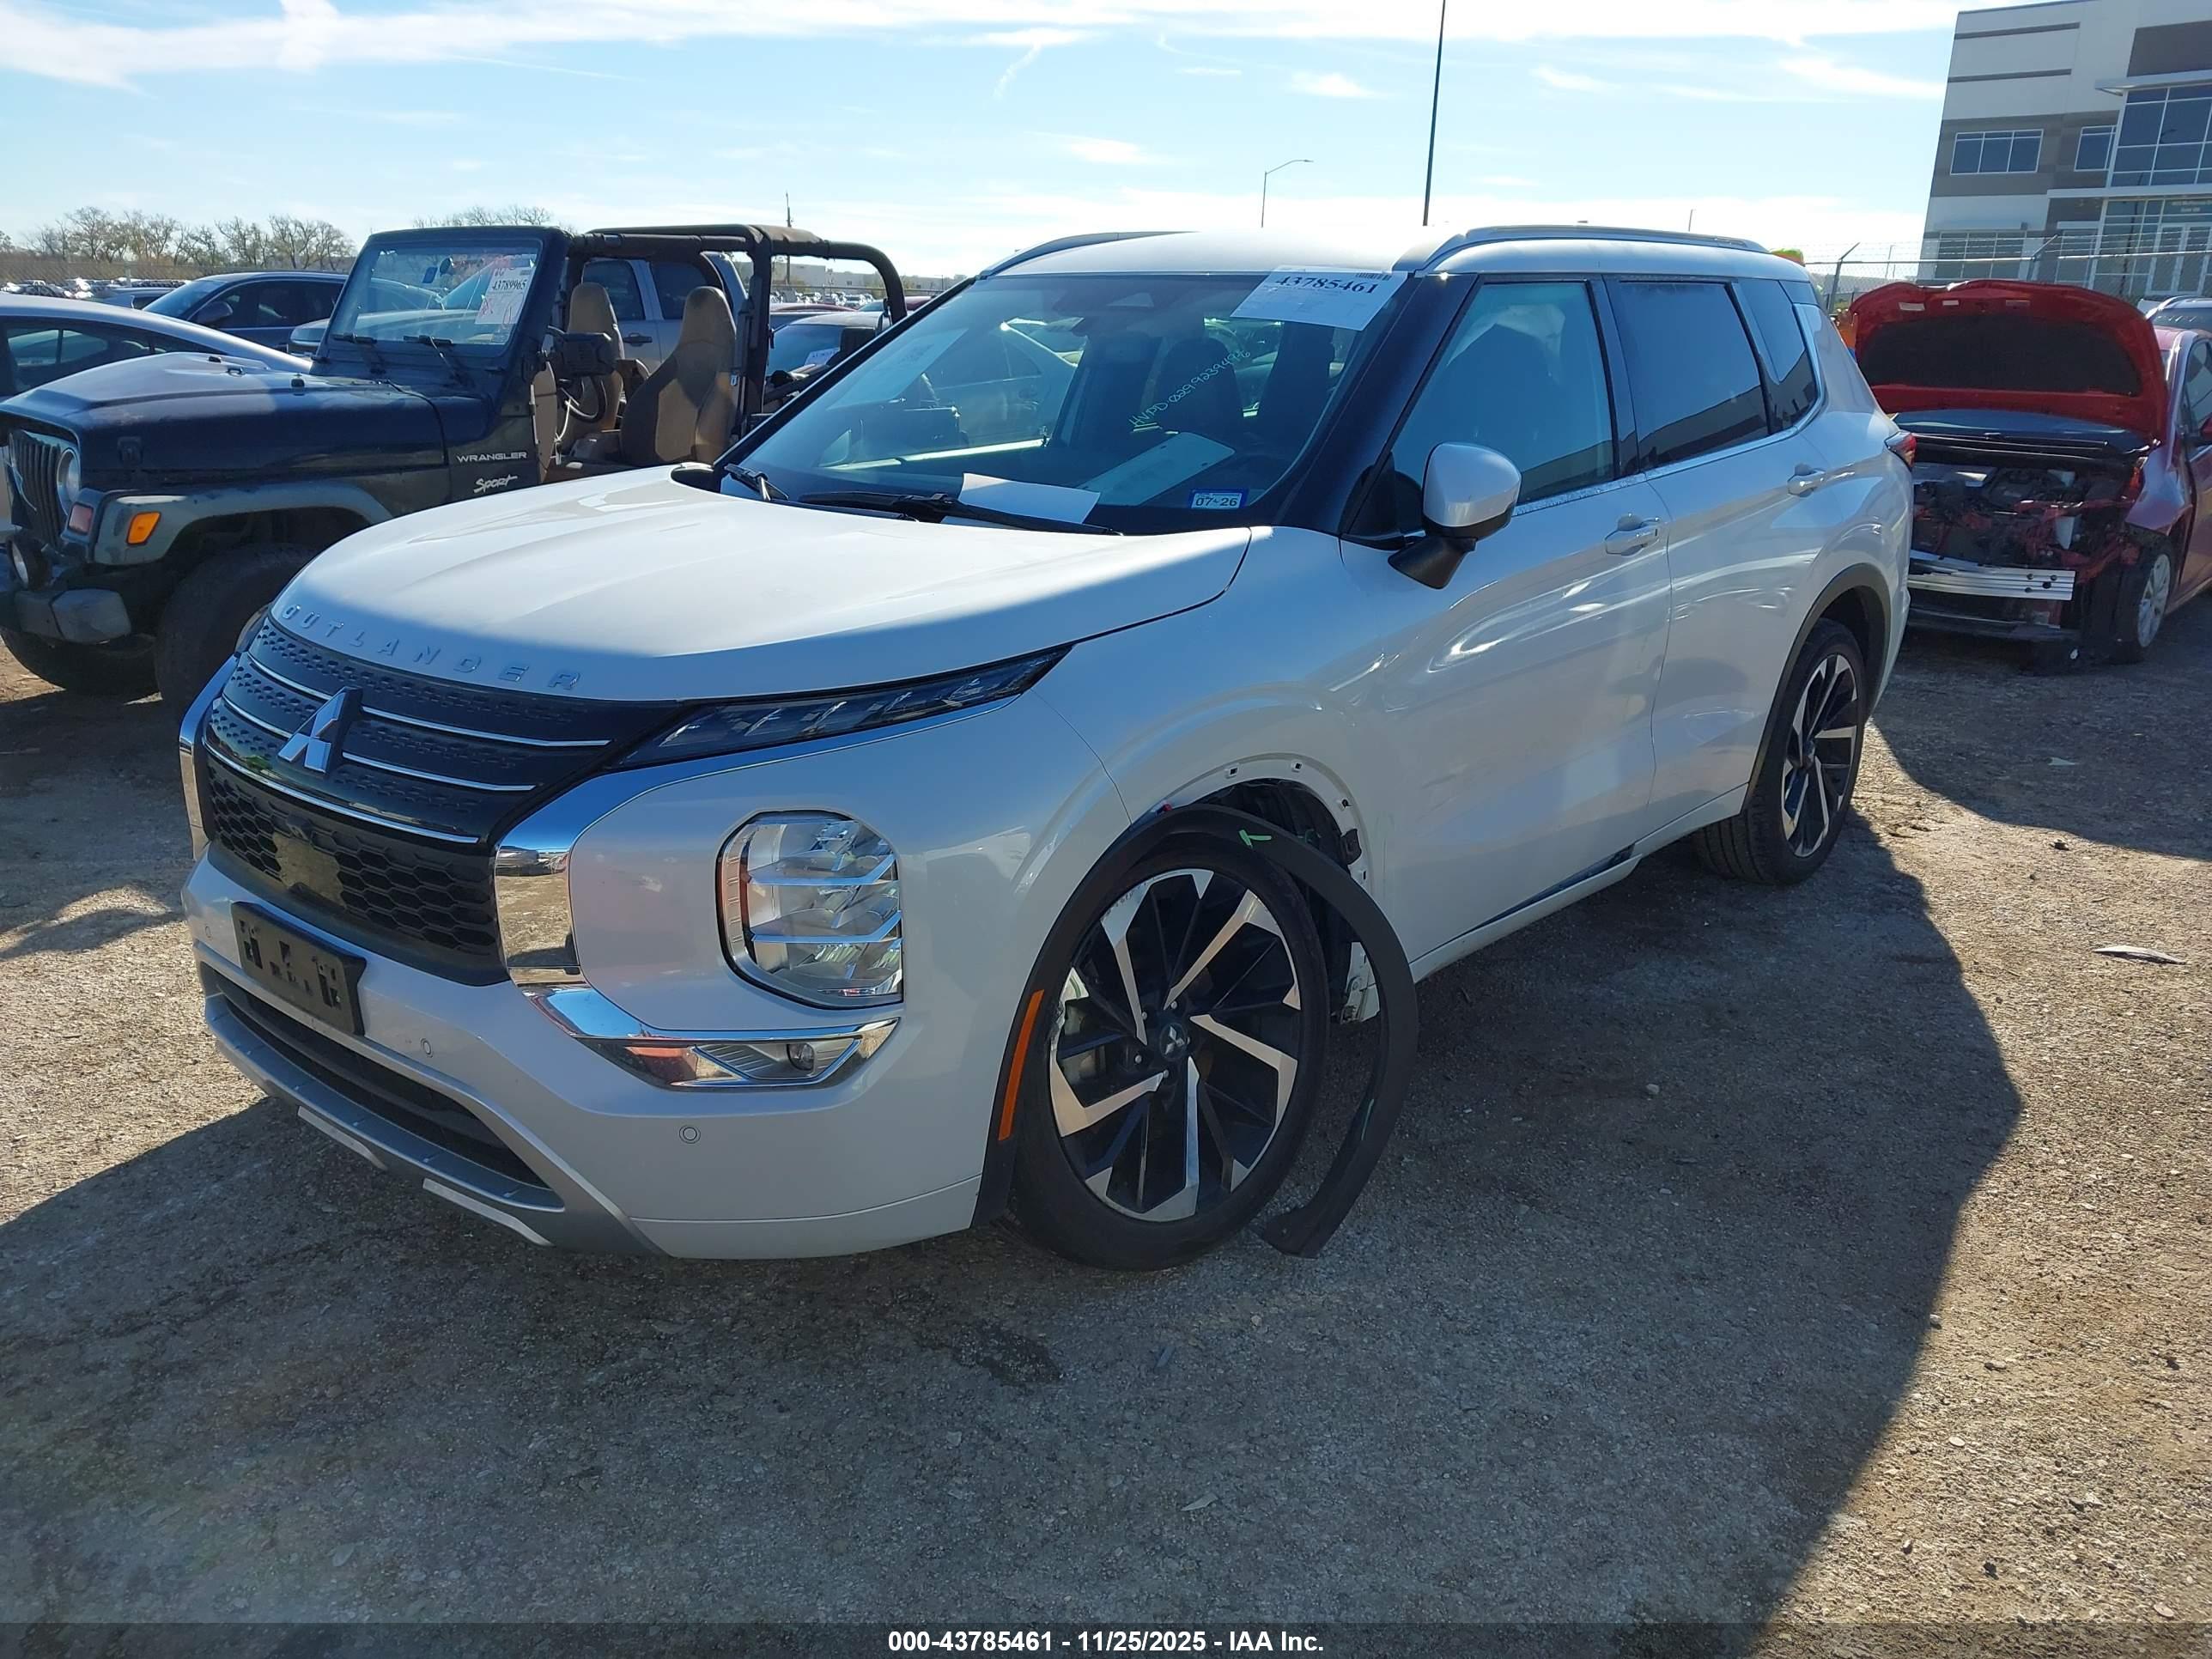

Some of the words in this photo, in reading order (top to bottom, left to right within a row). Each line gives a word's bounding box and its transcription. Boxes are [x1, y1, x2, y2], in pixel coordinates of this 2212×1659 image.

[1276, 275, 1379, 295] 43785461
[456, 452, 527, 463] WRANGLER
[281, 603, 582, 690] OUTLANDER
